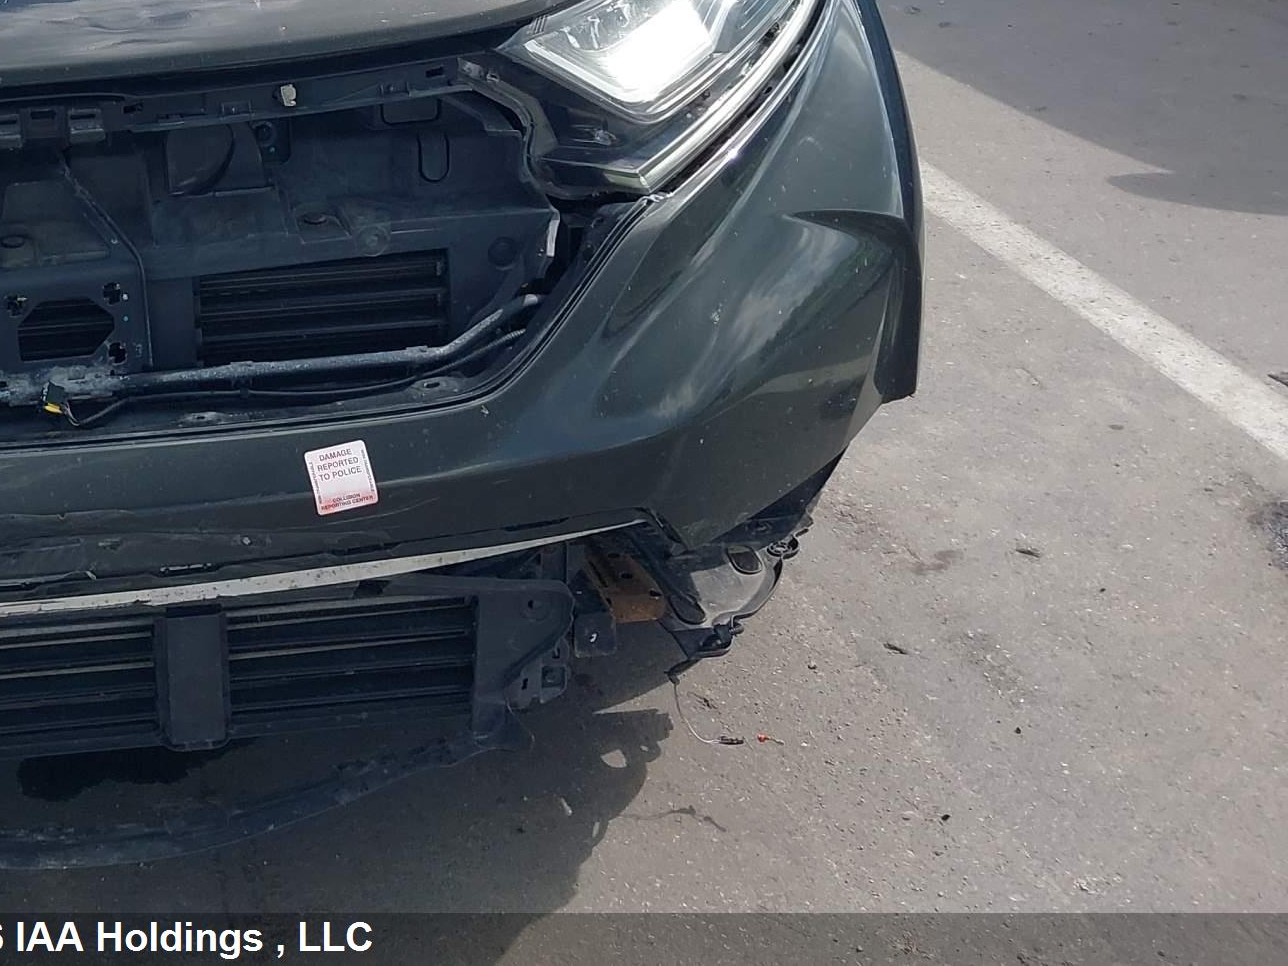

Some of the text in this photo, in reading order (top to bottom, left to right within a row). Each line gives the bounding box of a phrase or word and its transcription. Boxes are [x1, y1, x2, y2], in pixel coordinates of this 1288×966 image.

[319, 448, 352, 462] DAMAGE
[317, 456, 359, 472] REPORTED
[318, 465, 362, 482] TO POLICE
